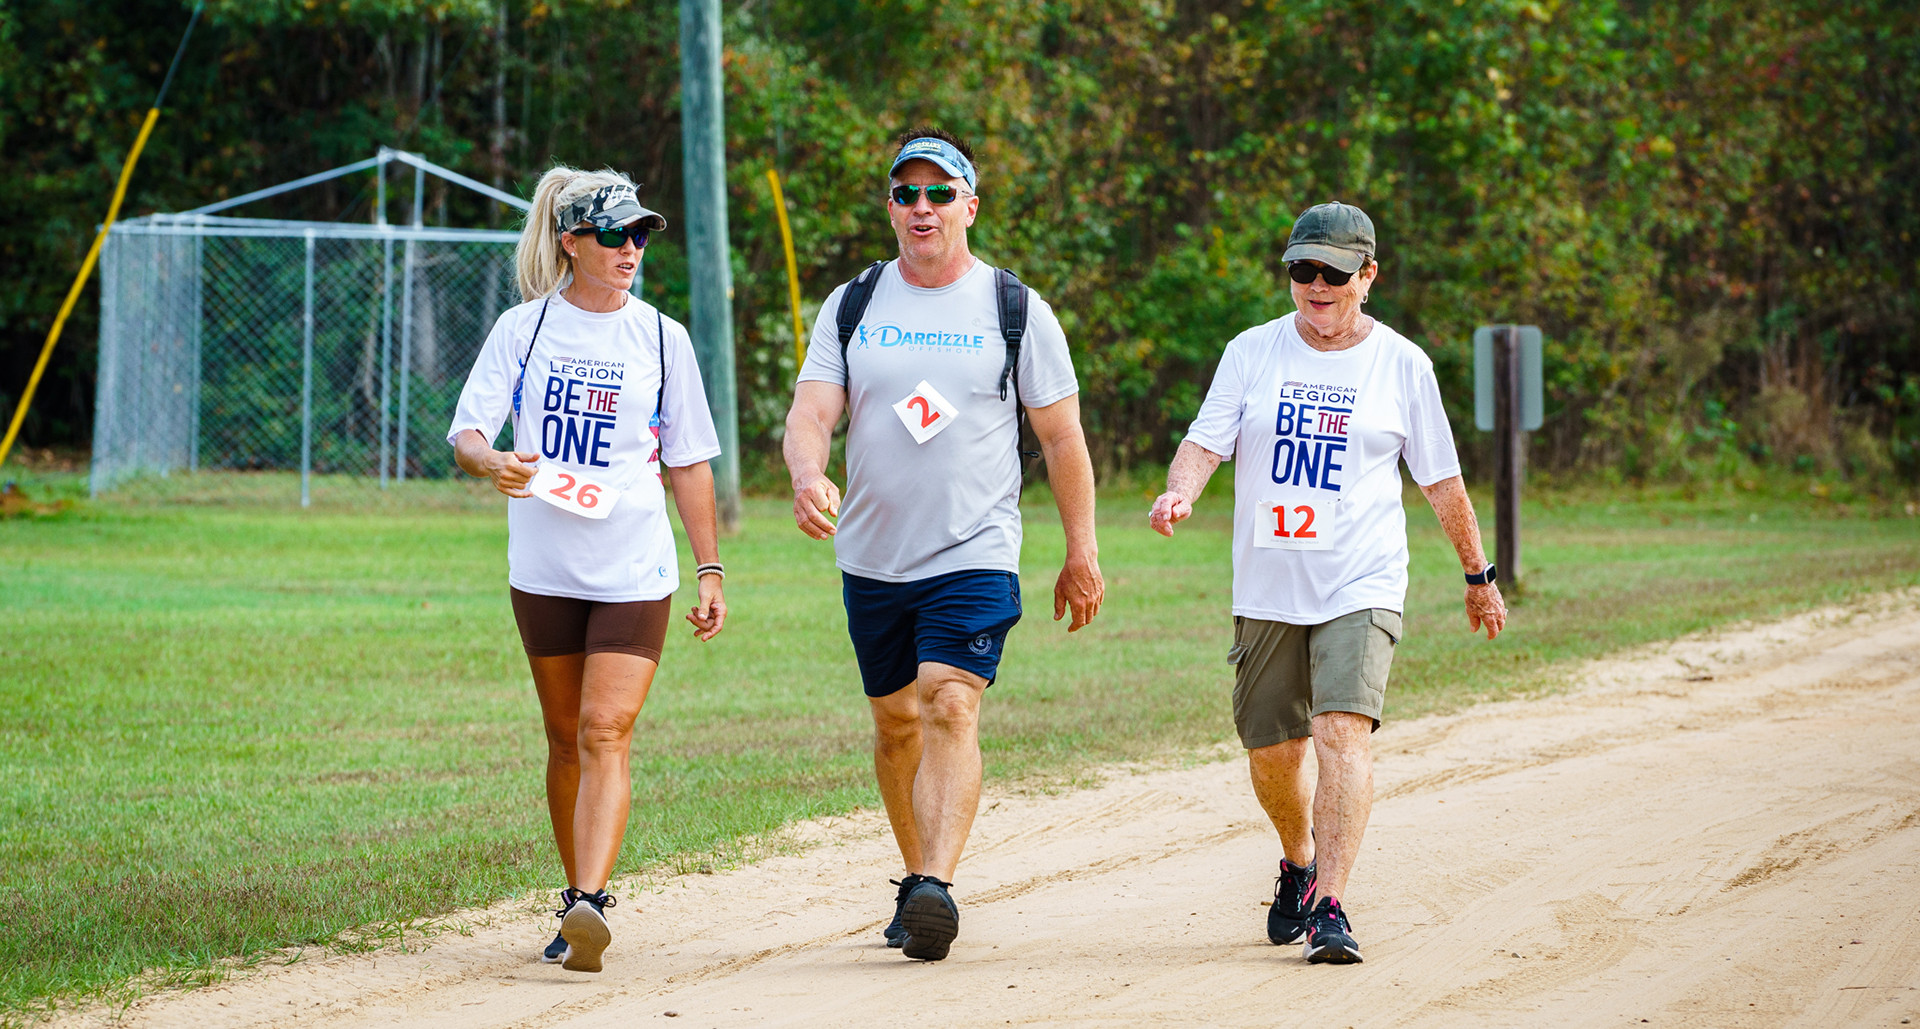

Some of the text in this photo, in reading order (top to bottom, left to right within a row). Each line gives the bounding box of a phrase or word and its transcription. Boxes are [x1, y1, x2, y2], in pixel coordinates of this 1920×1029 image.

[571, 358, 625, 368] AMERICAN
[909, 346, 980, 356] OFFSHORE
[550, 361, 624, 381] LEGION
[543, 375, 620, 416] BE THE
[1280, 388, 1356, 405] LEGION
[1302, 383, 1358, 394] AMERICAN
[906, 396, 941, 429] 2
[1275, 402, 1351, 439] BE THE
[542, 414, 616, 467] ONE
[1271, 438, 1347, 492] ONE
[549, 473, 603, 508] 26
[1272, 505, 1317, 538] 12
